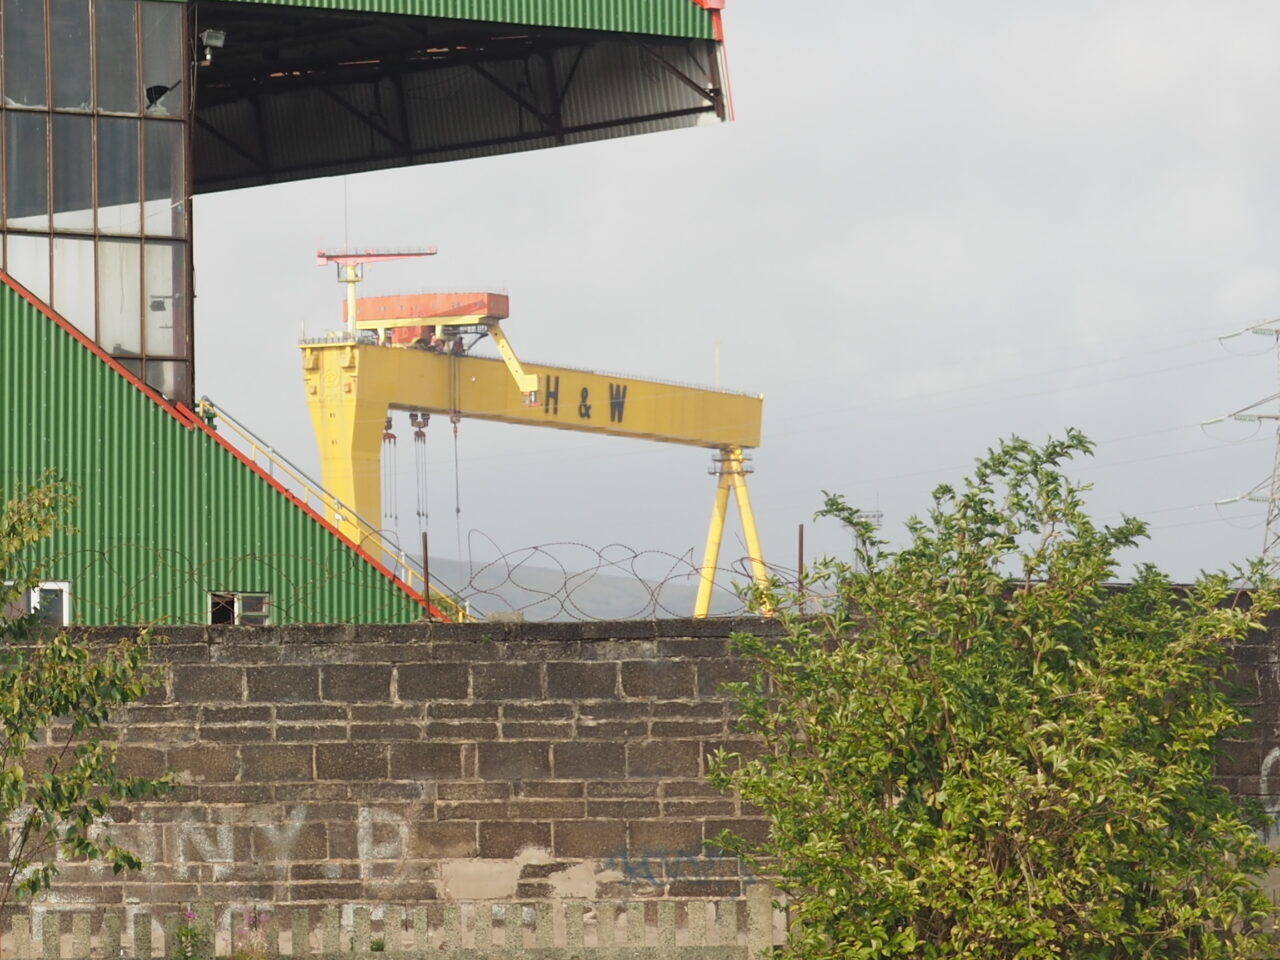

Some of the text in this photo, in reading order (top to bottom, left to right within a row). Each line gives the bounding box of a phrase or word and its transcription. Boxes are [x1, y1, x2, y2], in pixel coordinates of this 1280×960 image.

[545, 375, 627, 423] H & W
